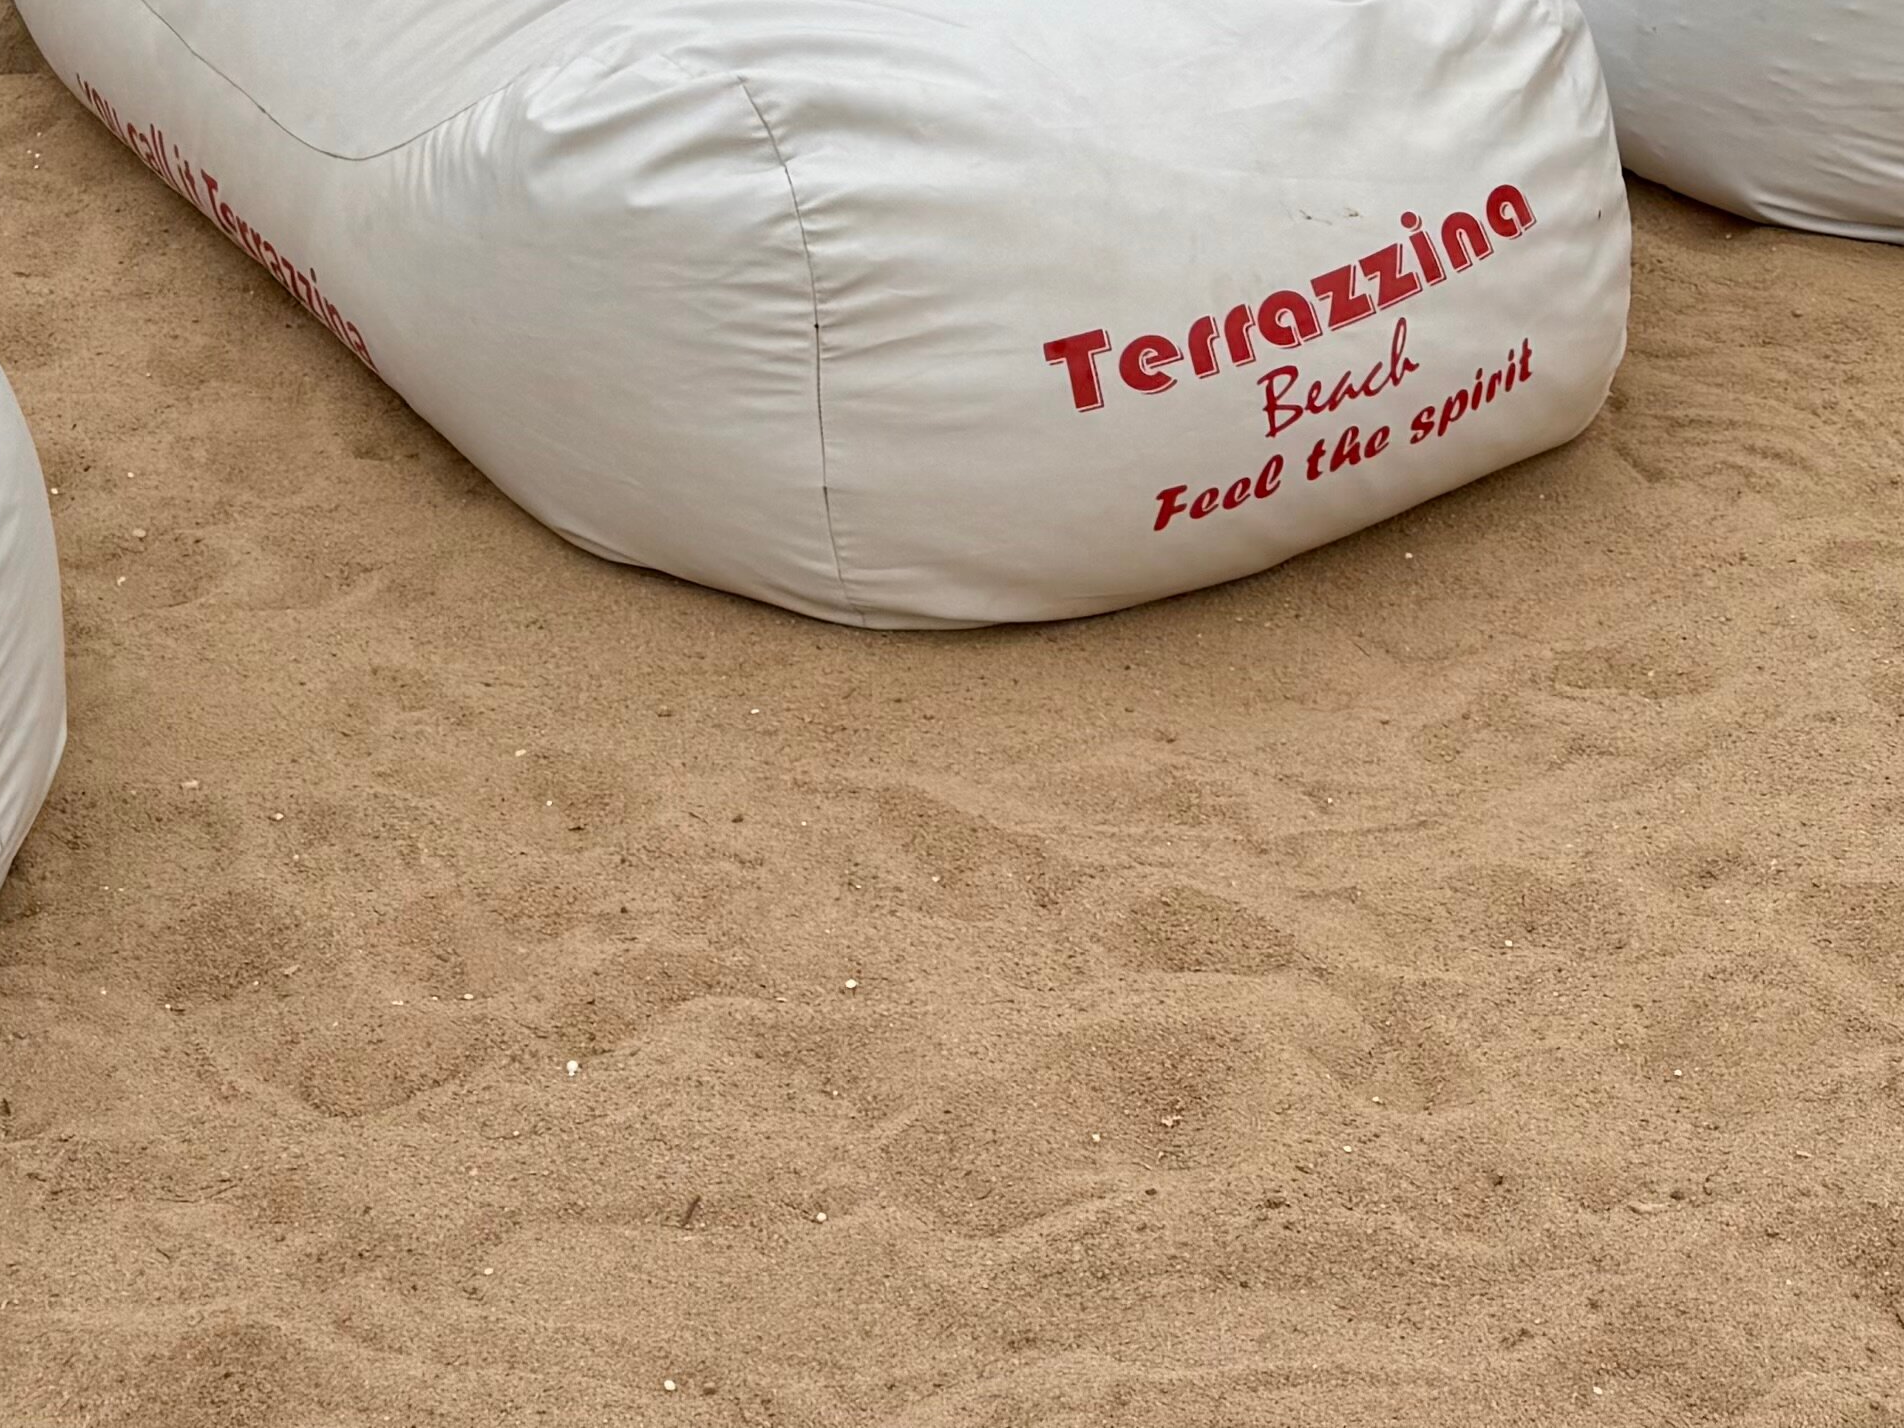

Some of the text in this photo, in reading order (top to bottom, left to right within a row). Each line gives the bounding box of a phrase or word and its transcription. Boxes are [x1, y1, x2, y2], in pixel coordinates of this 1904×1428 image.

[1043, 184, 1537, 413] Terrazzina
[1256, 316, 1420, 439] Beach
[1152, 337, 1534, 532] Feel the spirit
